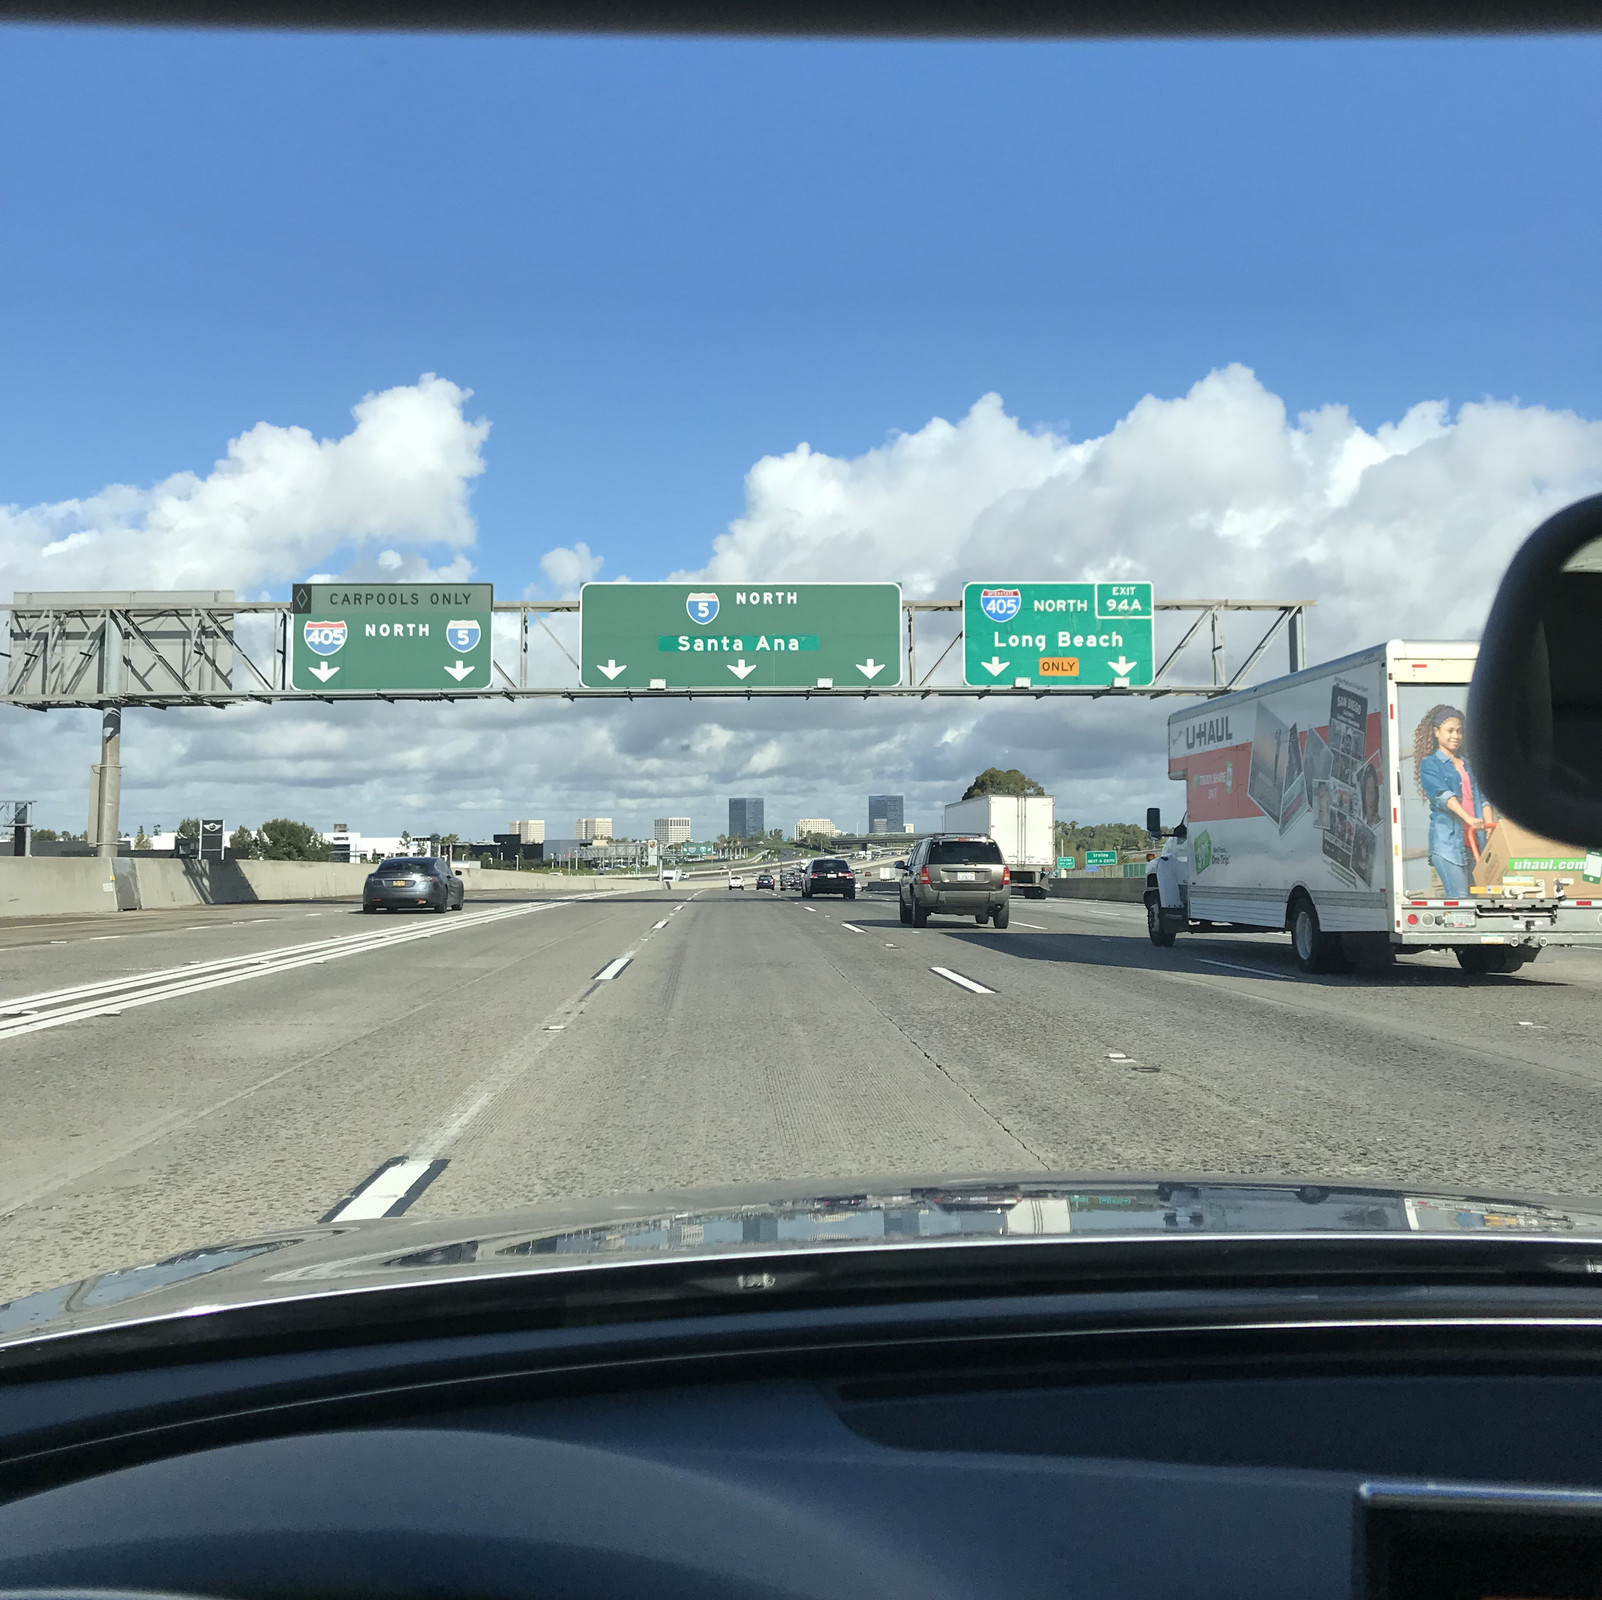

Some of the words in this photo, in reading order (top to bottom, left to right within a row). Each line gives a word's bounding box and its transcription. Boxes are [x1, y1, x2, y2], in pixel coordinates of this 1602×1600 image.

[1112, 586, 1135, 596] EXIT
[330, 592, 419, 605] CARPOOLS
[430, 592, 472, 605] ONLY
[736, 592, 798, 605] NORTH
[1106, 599, 1142, 612] 94A
[697, 602, 710, 618] 5
[986, 599, 1017, 614] 405
[1034, 600, 1088, 612] NORTH
[307, 629, 345, 645] 405
[365, 623, 430, 637] NORTH
[457, 630, 470, 645] 5
[678, 635, 744, 651] Santa
[755, 635, 800, 651] Ana
[994, 632, 1046, 651] Long
[1058, 631, 1123, 647] Beach
[1042, 661, 1076, 672] ONLY
[1186, 716, 1233, 750] U-HAUL
[1514, 858, 1588, 870] uhaul.com
